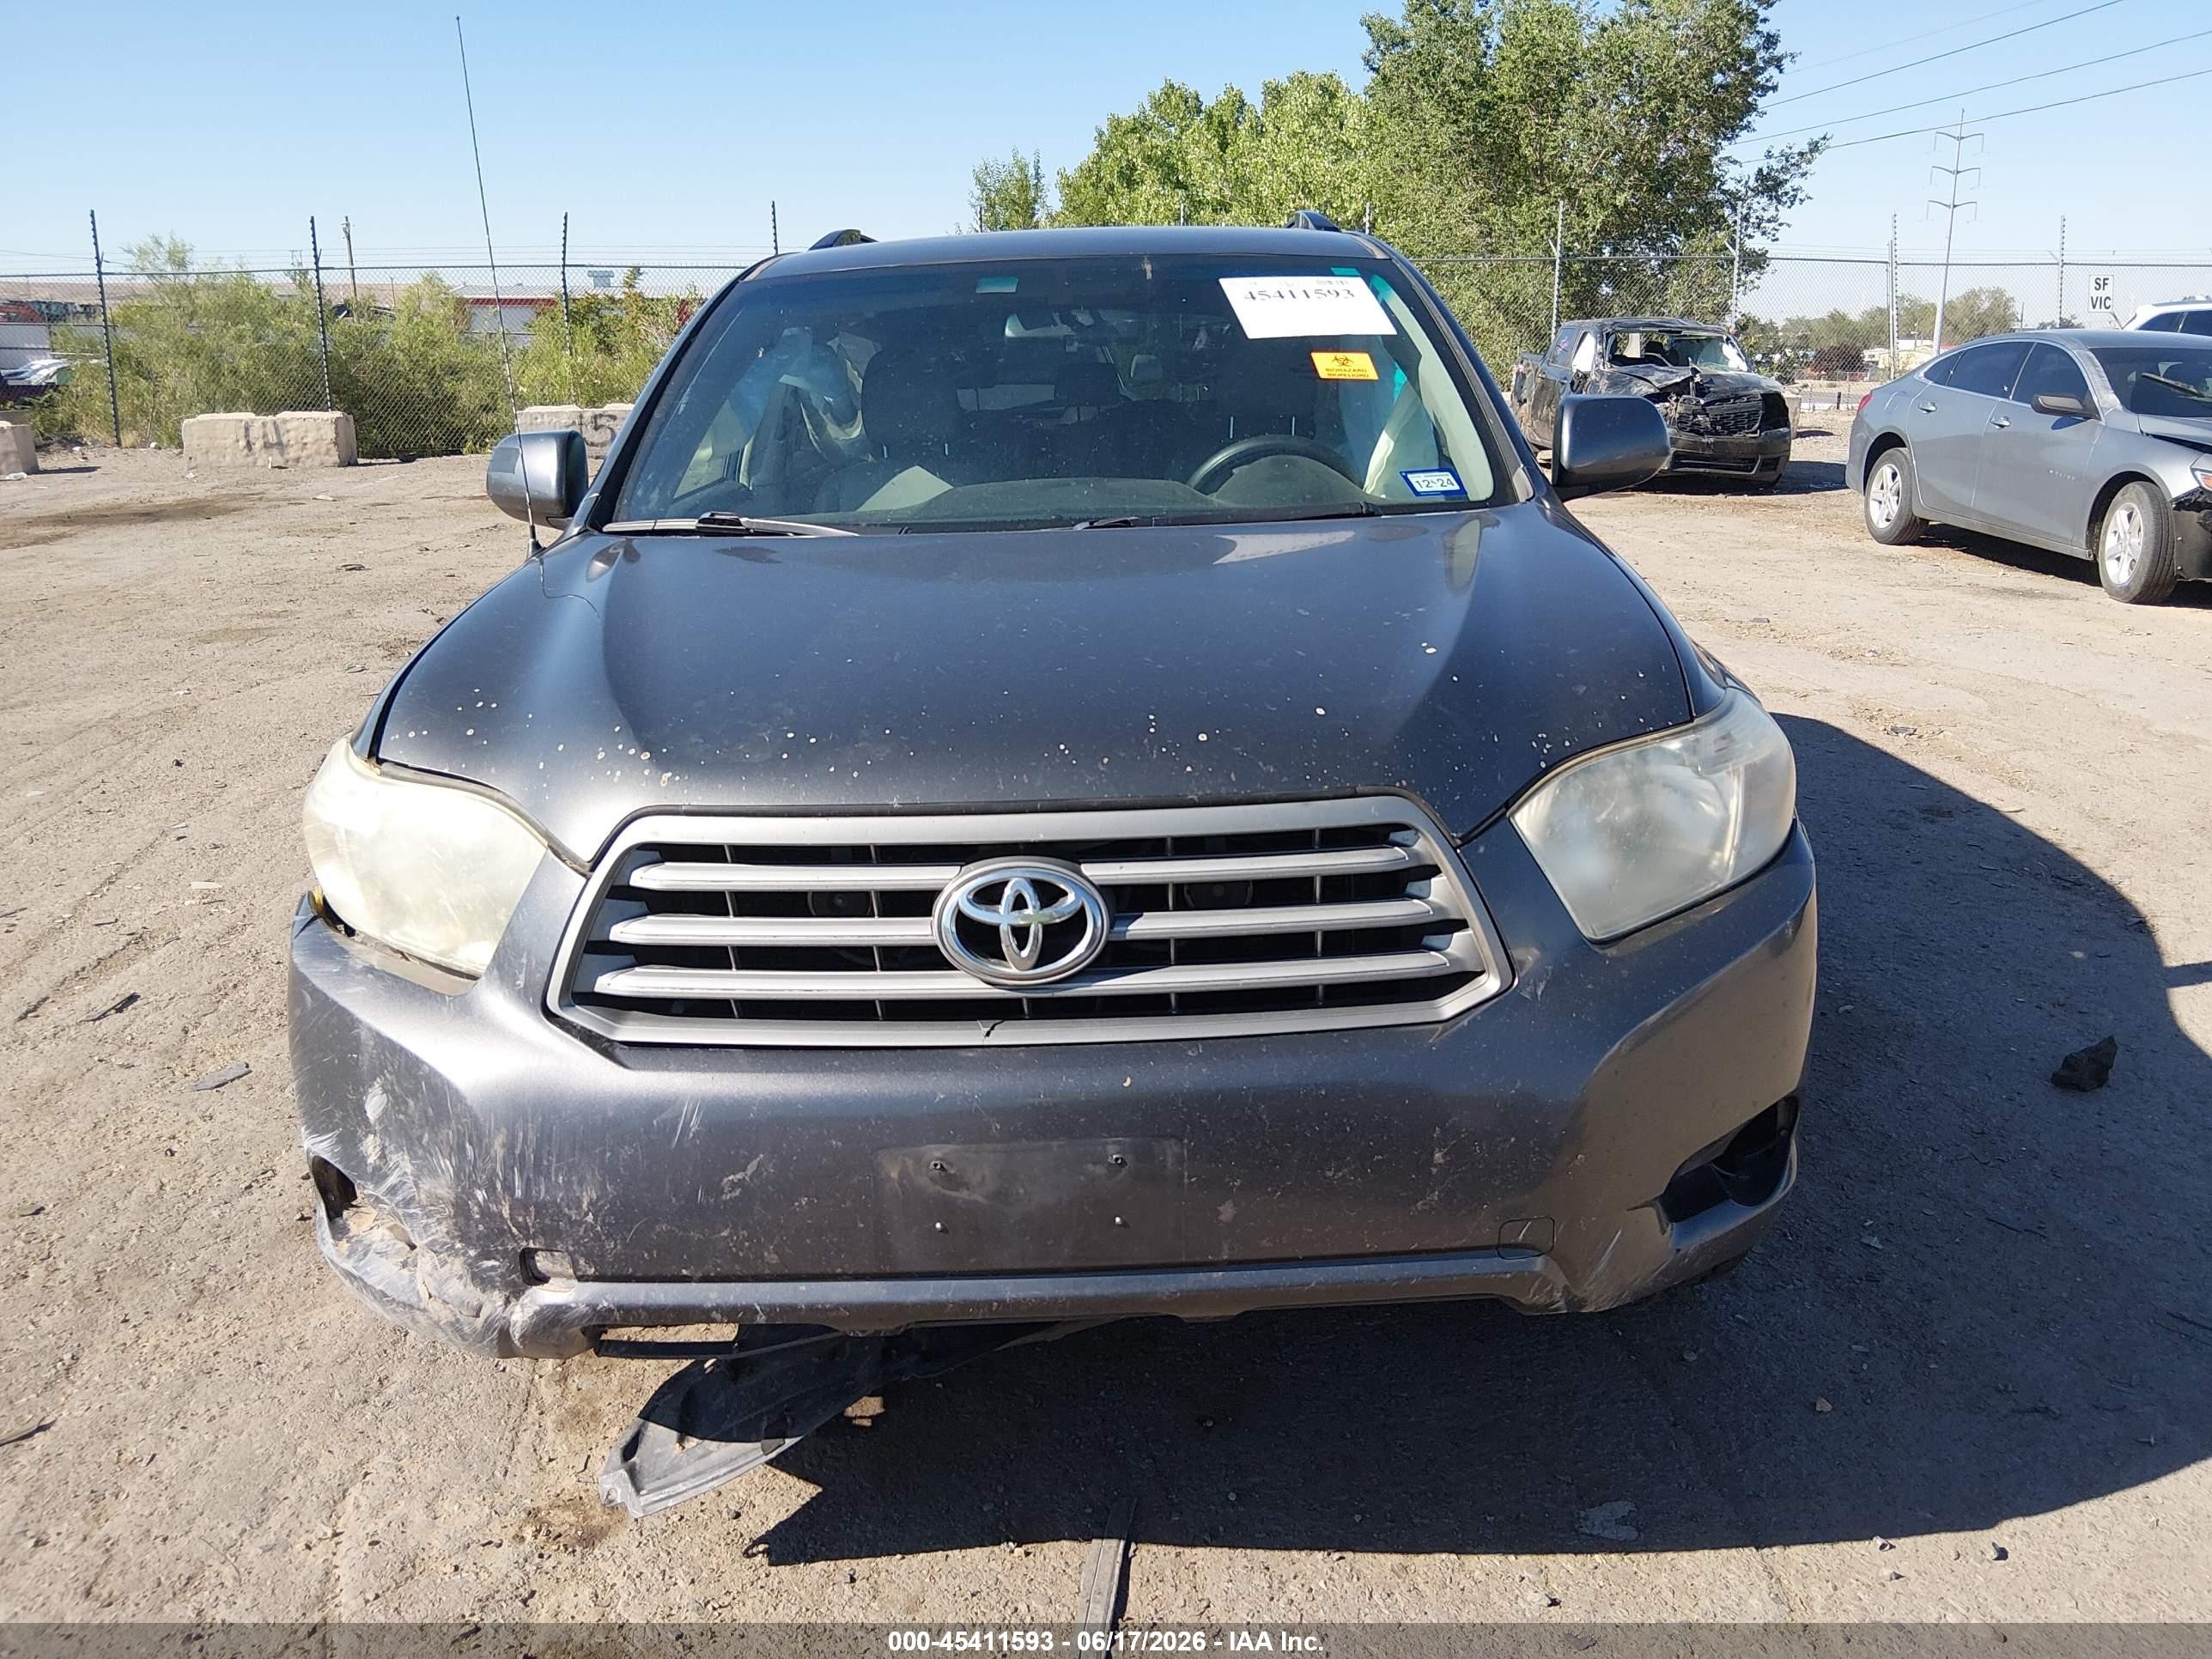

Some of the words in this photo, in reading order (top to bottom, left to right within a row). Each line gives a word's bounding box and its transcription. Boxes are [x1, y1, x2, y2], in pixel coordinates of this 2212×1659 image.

[2094, 277, 2110, 291] SF
[1243, 288, 1356, 301] 45411593
[2090, 295, 2112, 310] VIC
